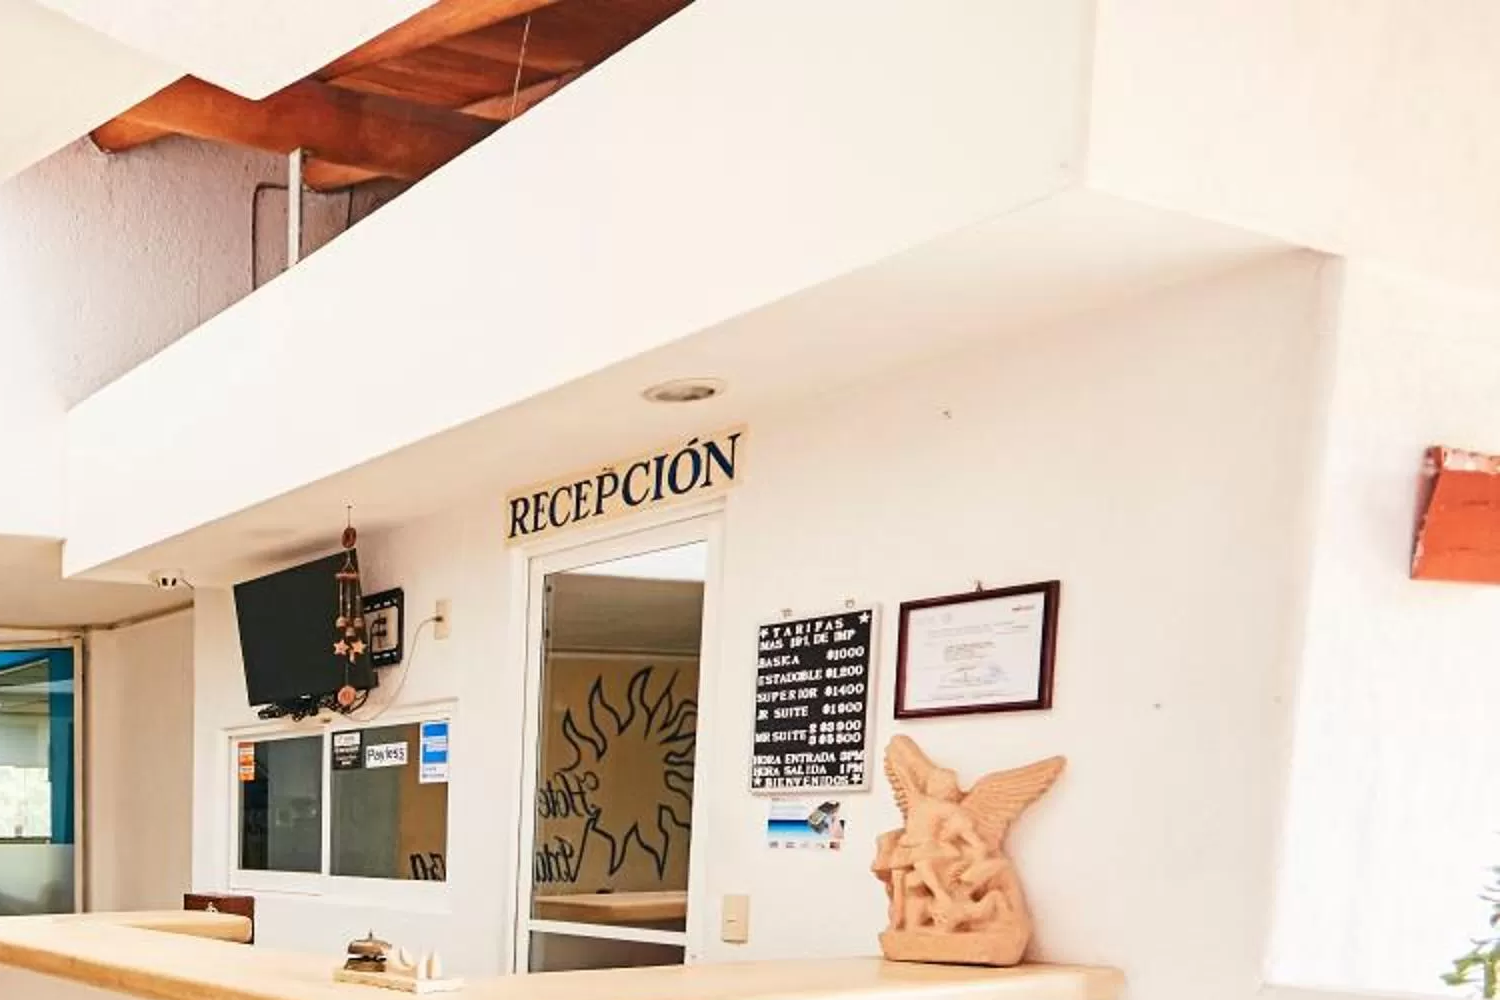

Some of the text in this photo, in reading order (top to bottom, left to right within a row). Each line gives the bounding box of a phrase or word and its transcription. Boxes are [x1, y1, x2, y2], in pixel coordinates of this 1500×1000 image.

[508, 433, 741, 538] RECEPCIÓN
[773, 619, 844, 639] TARIFAS
[813, 633, 828, 644] DE
[826, 646, 864, 660] $1000
[756, 688, 817, 703] SUPERIOR
[773, 706, 809, 719] SUITE
[772, 729, 807, 742] SUITE
[785, 752, 837, 763] ENTRADA
[784, 765, 827, 776] SALIDA
[764, 775, 849, 787] BIENVENIDOS
